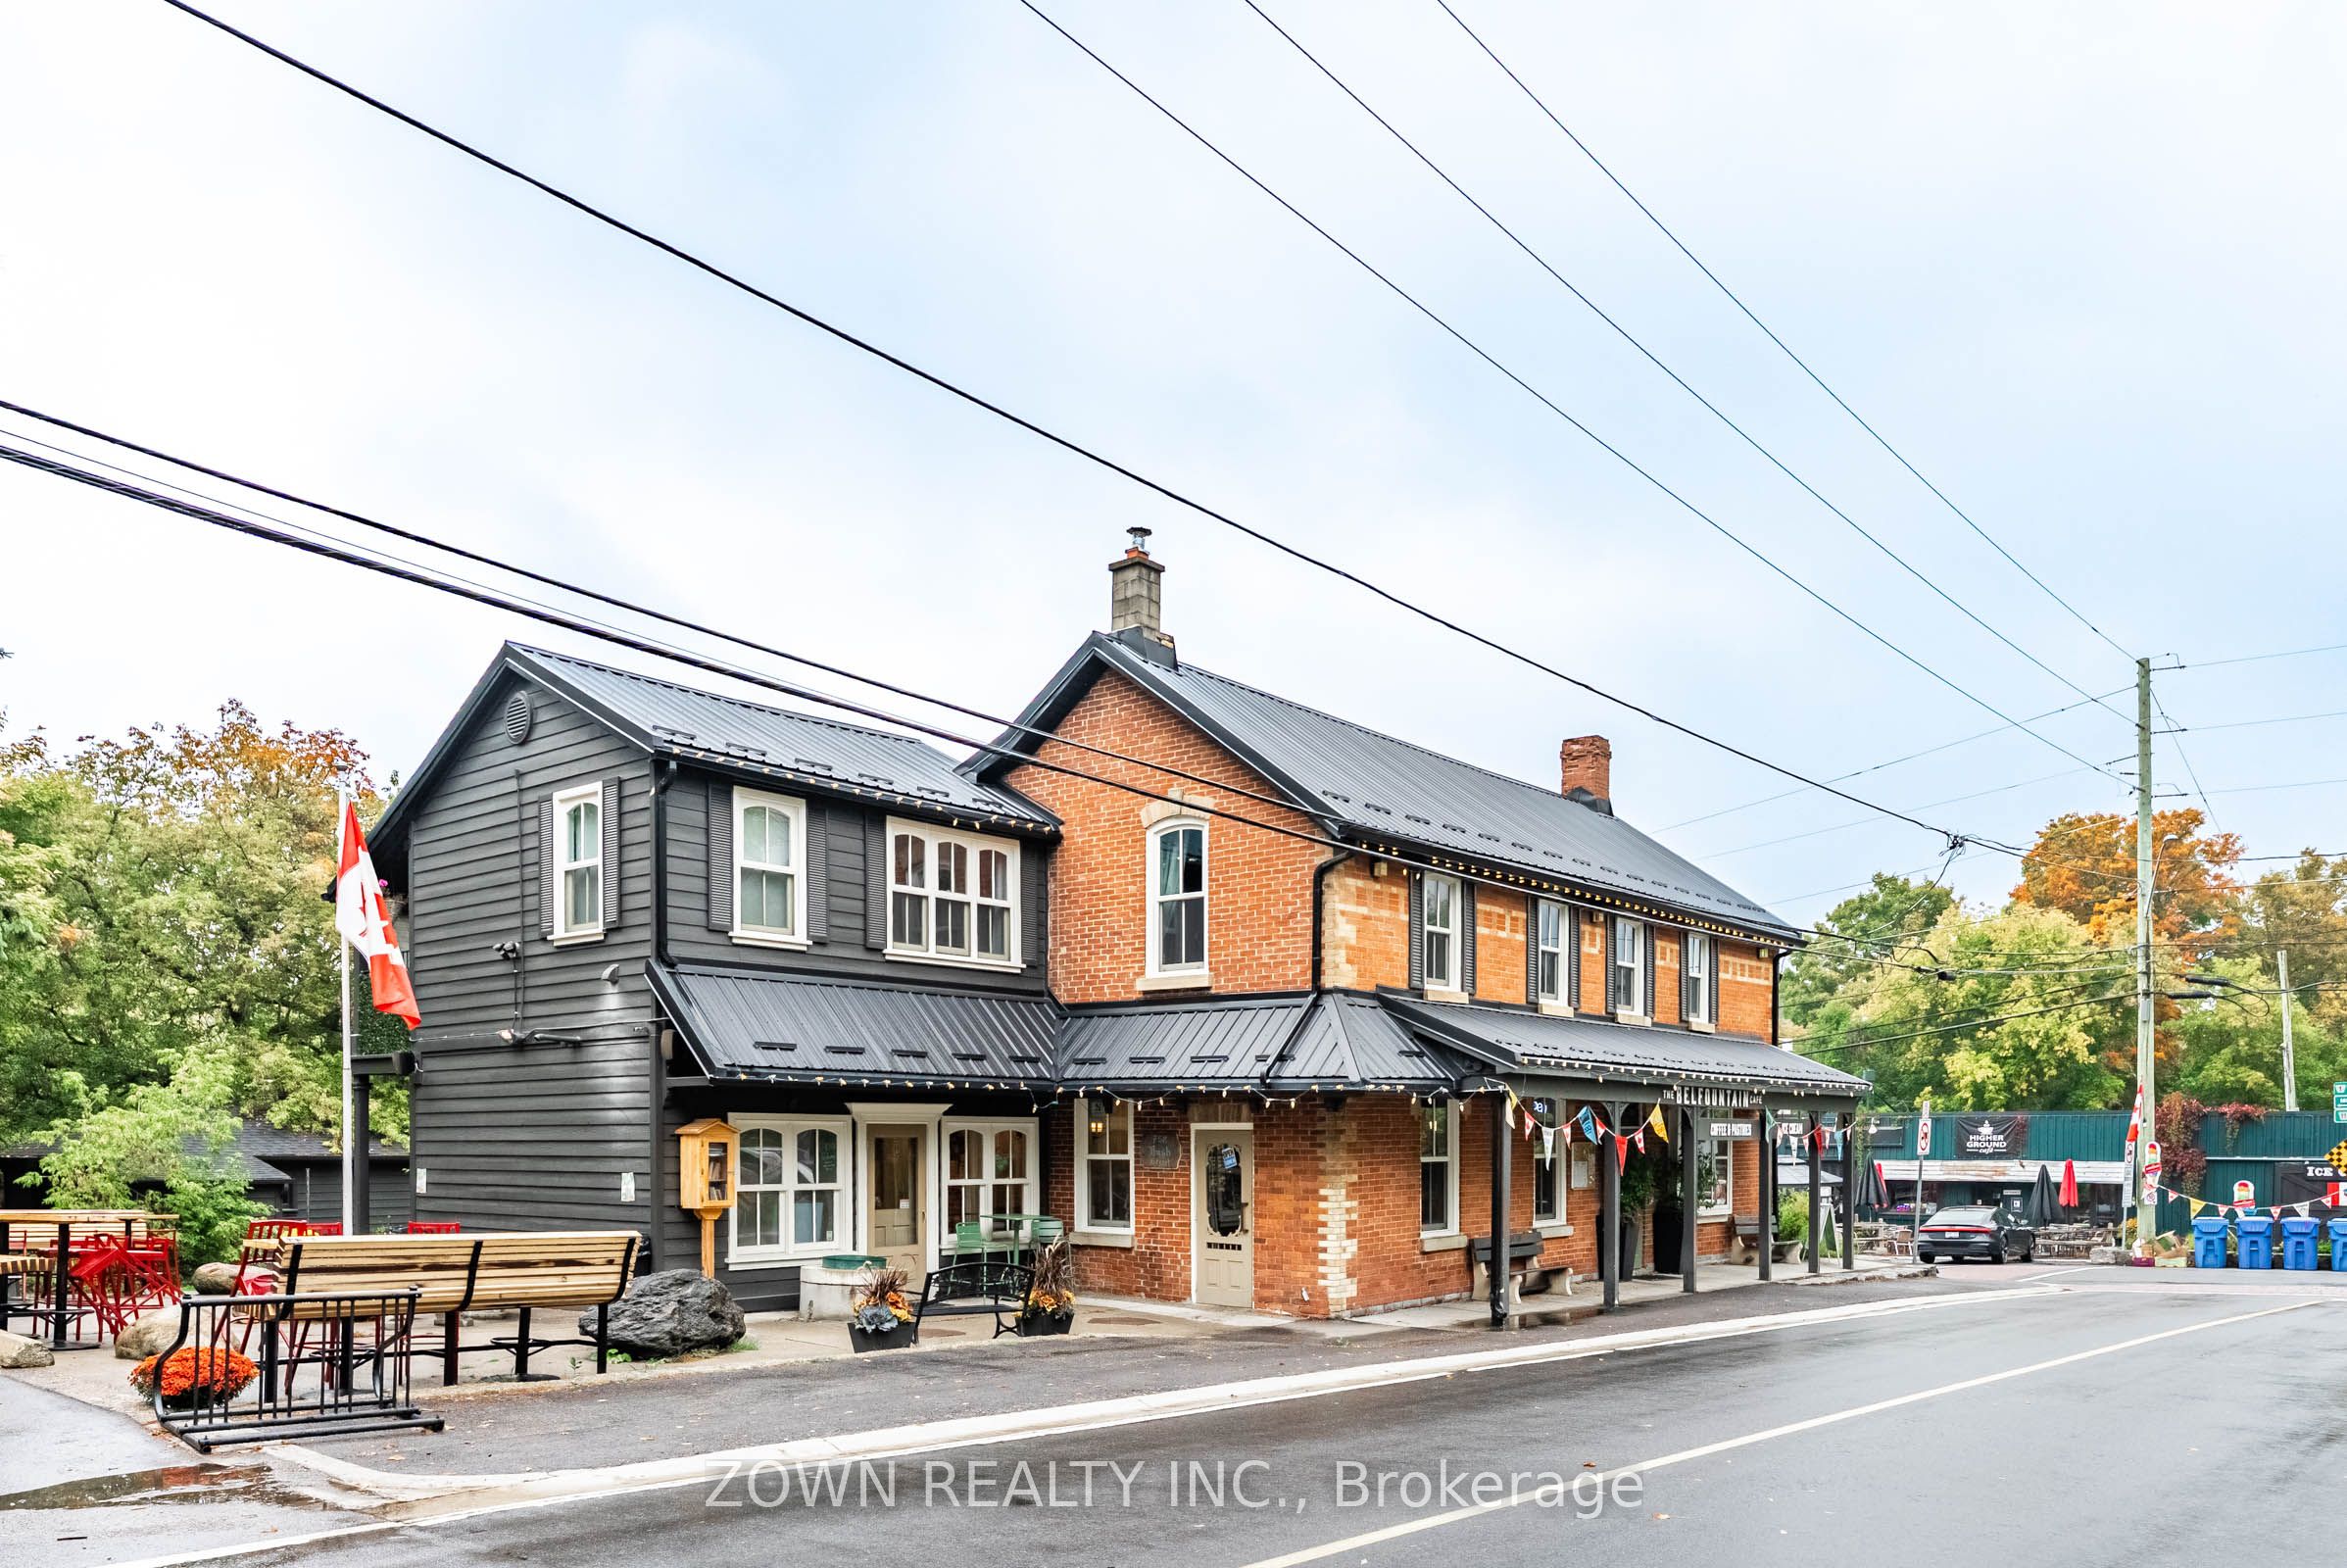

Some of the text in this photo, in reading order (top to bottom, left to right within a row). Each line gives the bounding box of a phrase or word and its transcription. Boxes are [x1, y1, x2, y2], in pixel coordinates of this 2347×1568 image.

[1663, 1090, 1675, 1100] THE
[1676, 1086, 1749, 1107] BELFOUNTAIN
[2306, 1166, 2333, 1177] ICE
